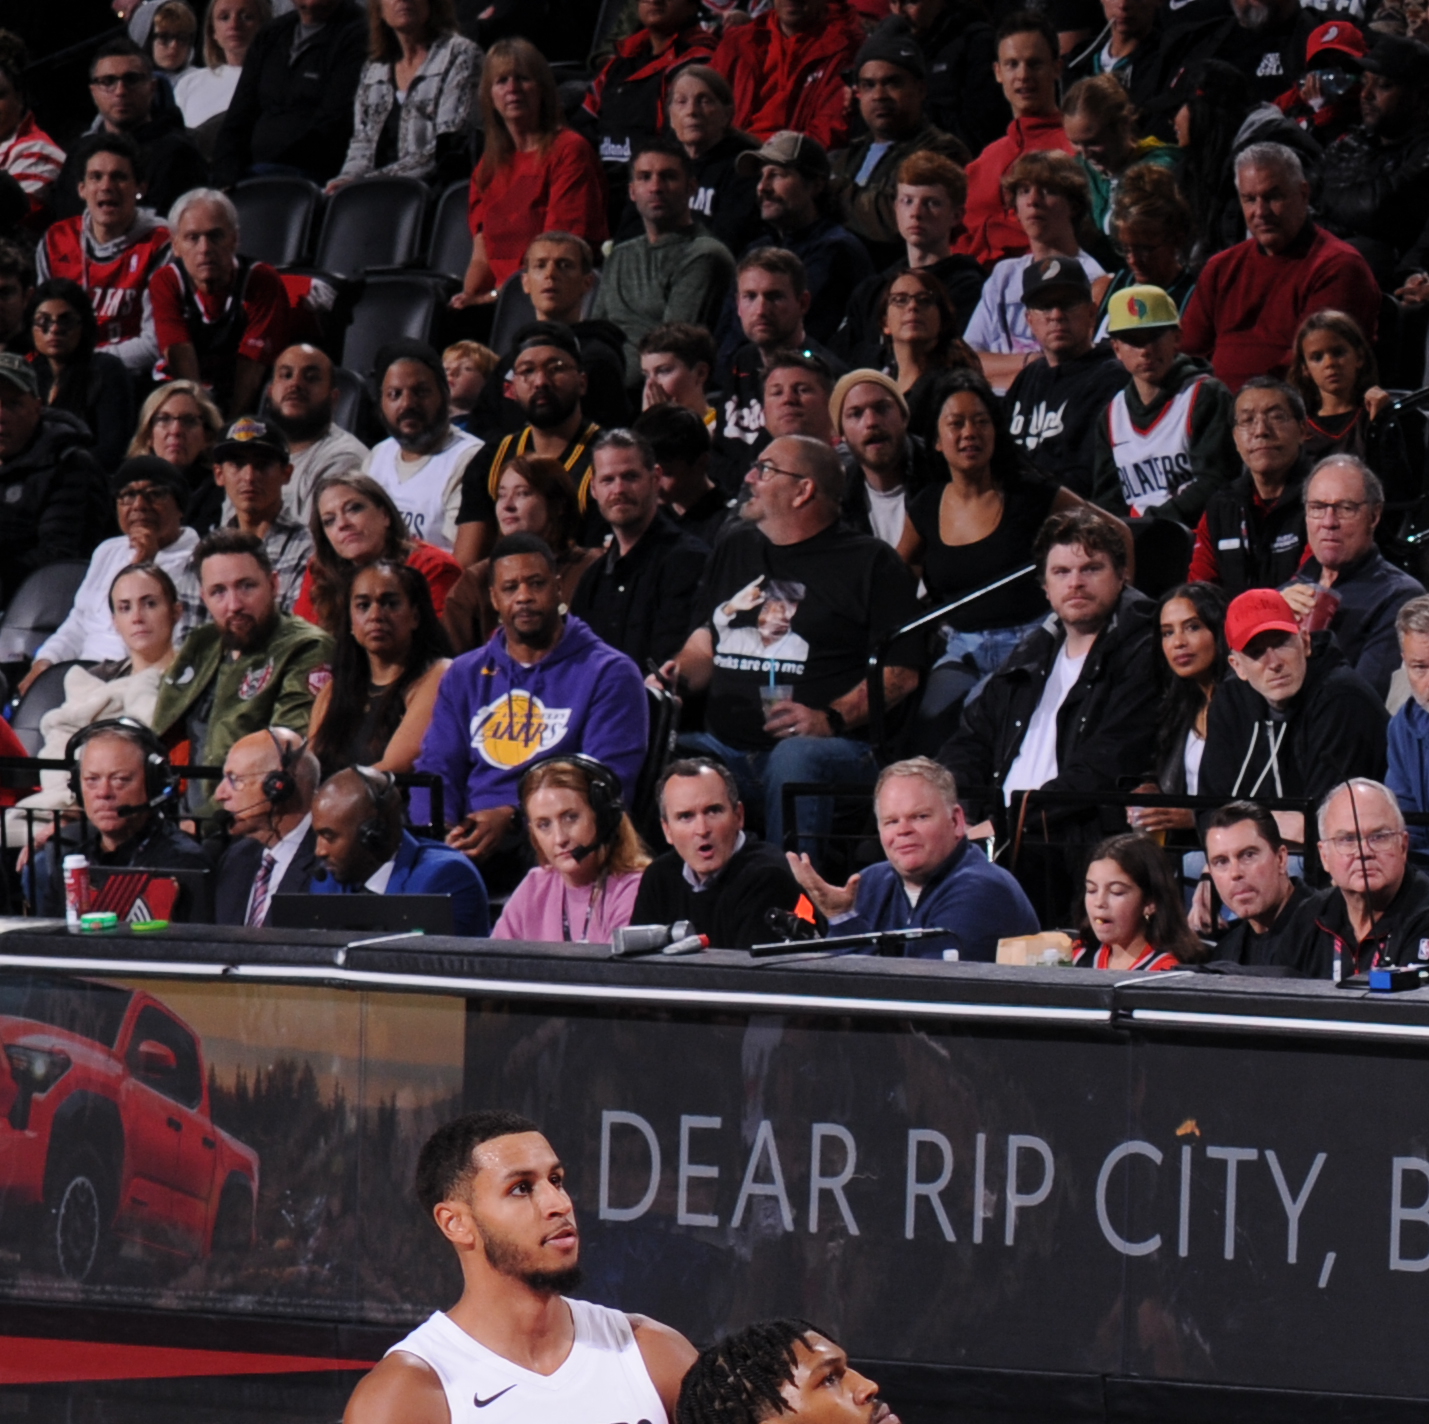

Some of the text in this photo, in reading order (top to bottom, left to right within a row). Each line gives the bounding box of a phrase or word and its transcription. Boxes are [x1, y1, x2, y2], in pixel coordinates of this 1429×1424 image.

[598, 1110, 860, 1236] DEAR
[904, 1128, 1056, 1247] RIP
[1095, 1140, 1338, 1290] CITY,
